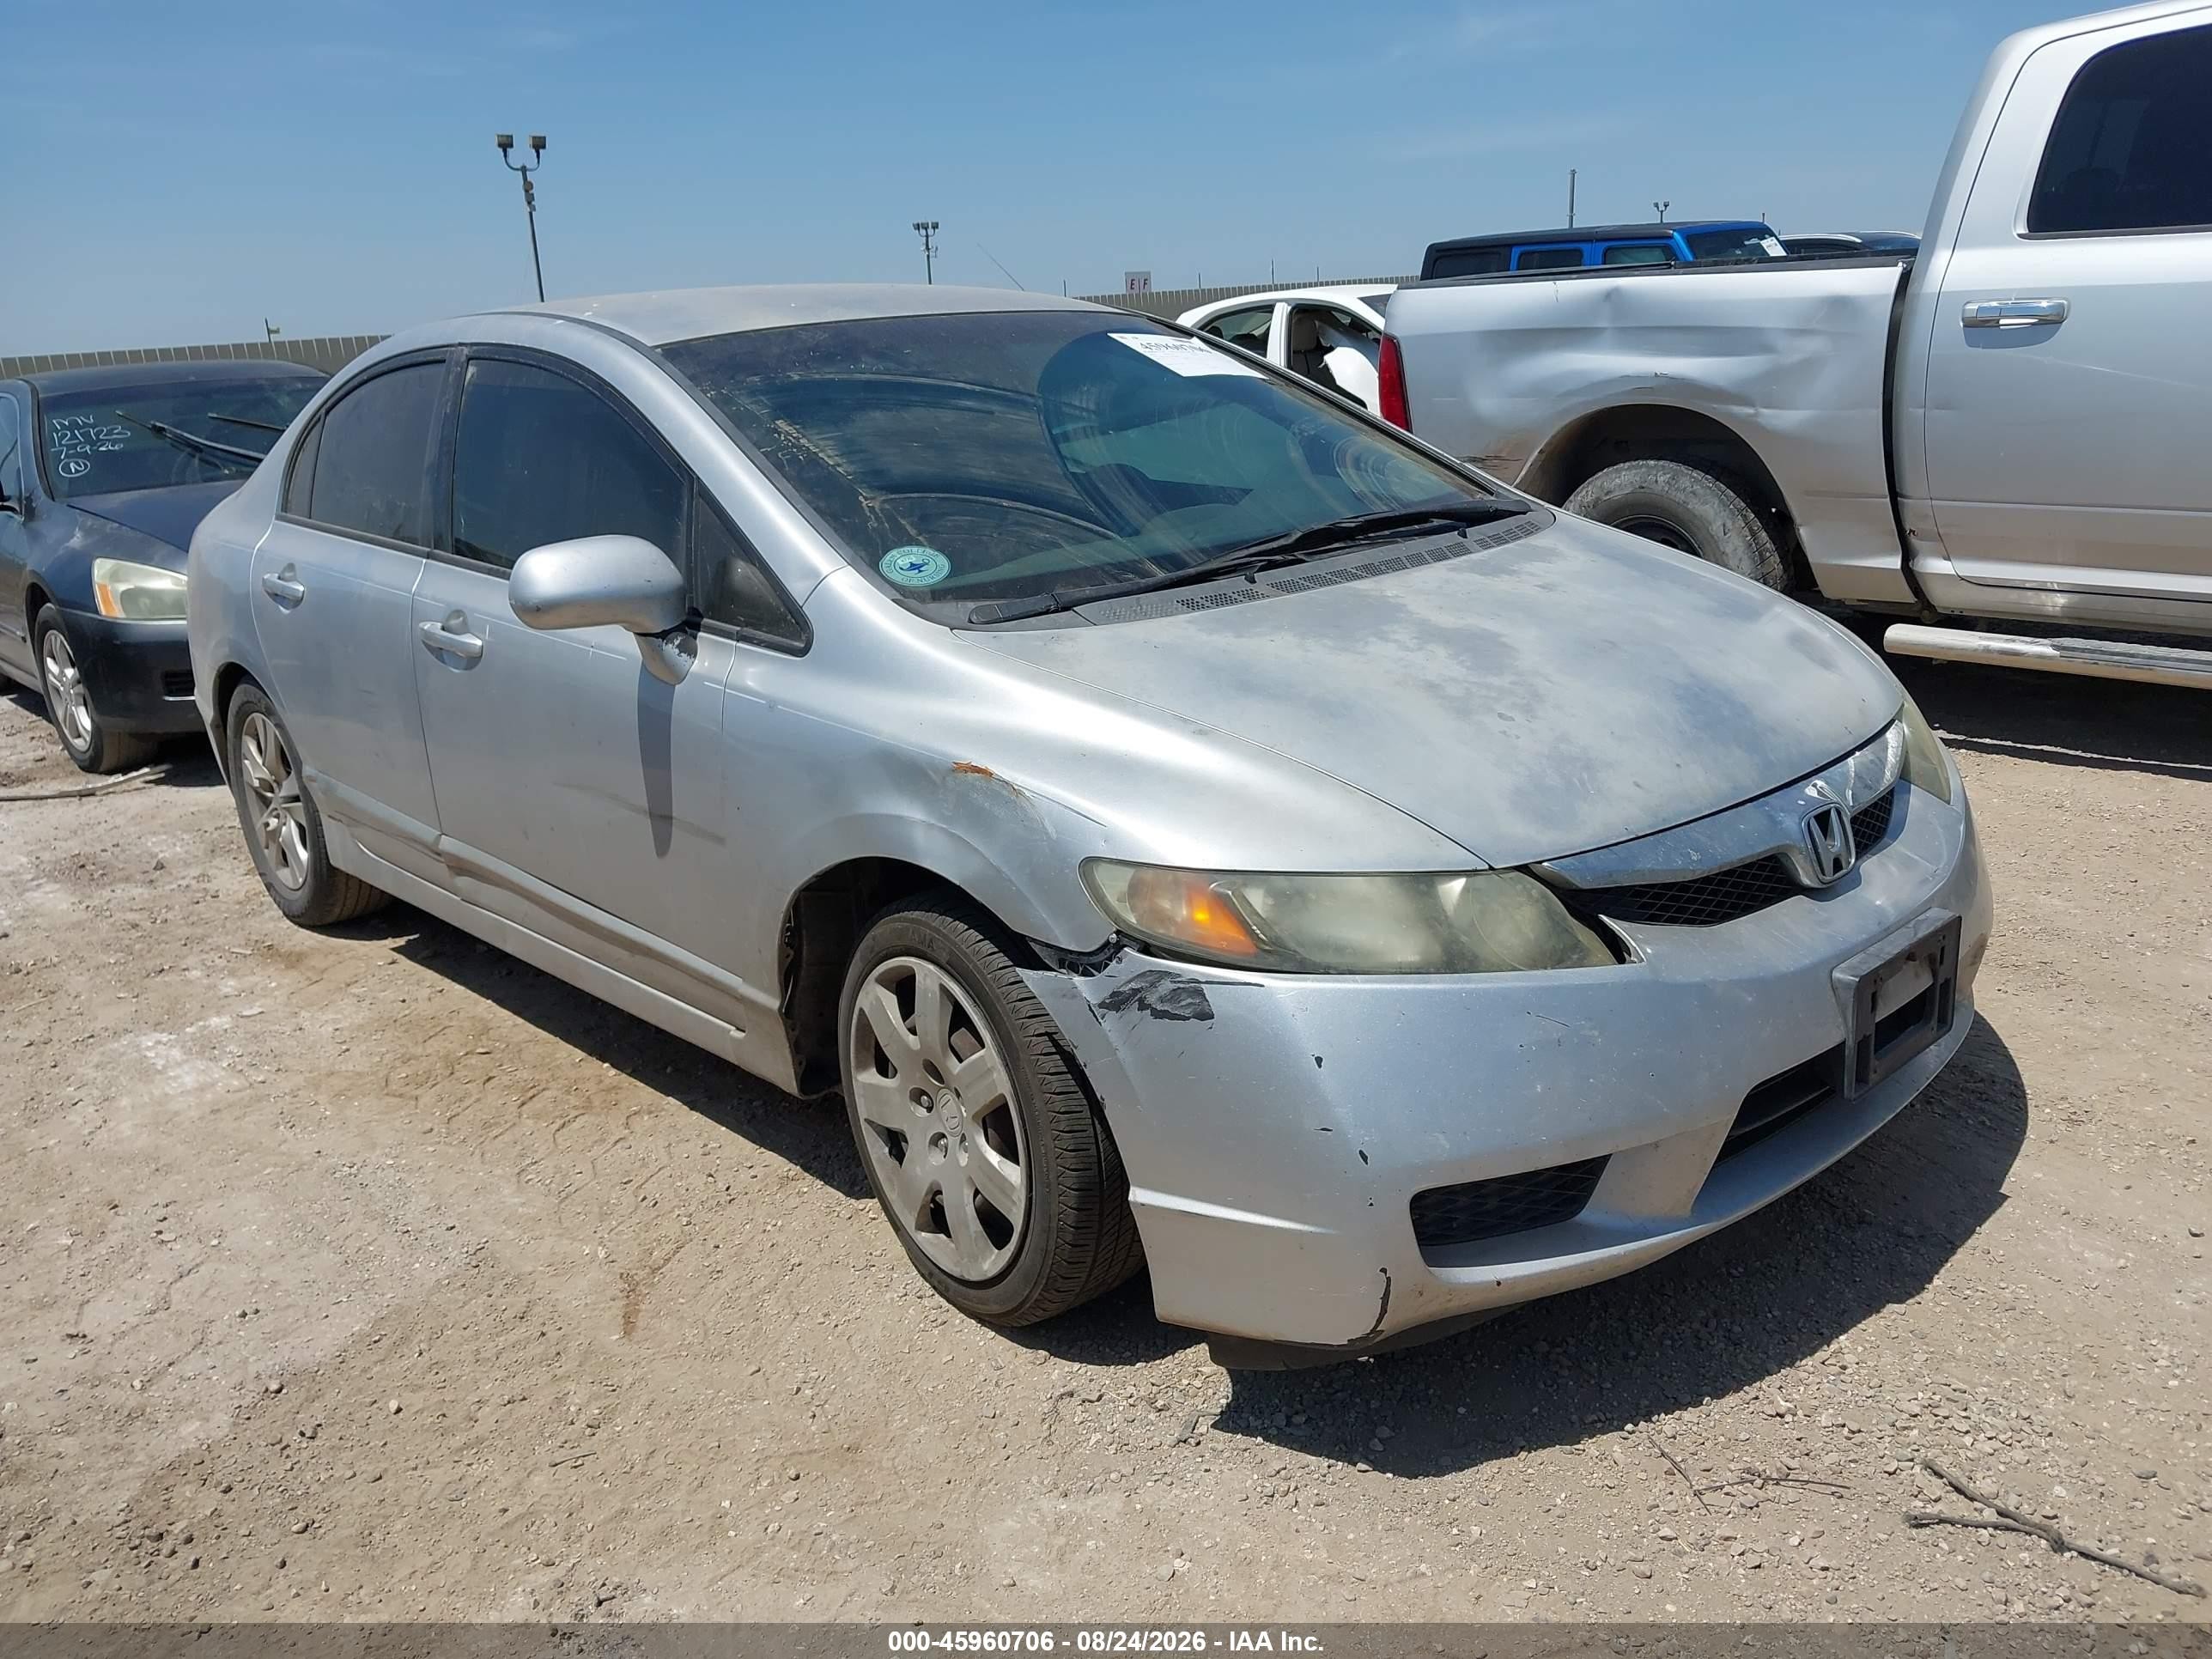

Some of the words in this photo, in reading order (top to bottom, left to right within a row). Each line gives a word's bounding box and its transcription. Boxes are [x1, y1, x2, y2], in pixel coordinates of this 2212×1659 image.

[1130, 278, 1135, 290] E
[1143, 278, 1148, 289] F
[52, 425, 131, 447] 121723
